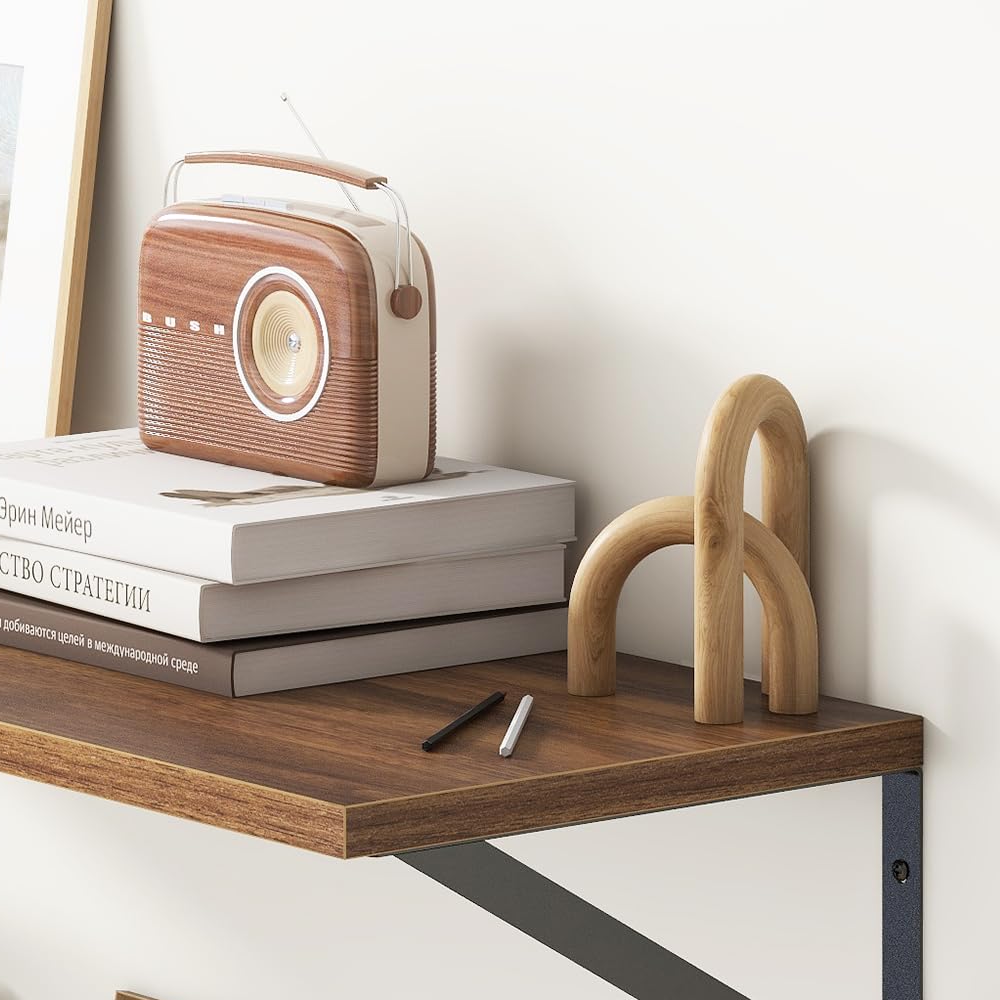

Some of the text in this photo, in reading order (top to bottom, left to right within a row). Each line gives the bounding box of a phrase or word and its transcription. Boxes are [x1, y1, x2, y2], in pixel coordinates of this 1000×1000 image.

[142, 311, 225, 336] BUSH
[0, 496, 93, 544] Эрин Мейер
[50, 564, 151, 613] СТРАТЕГИИ
[3, 616, 57, 641] добиваются
[57, 632, 85, 648] целей
[87, 638, 93, 649] в
[95, 640, 169, 667] международной
[171, 657, 199, 674] среде
